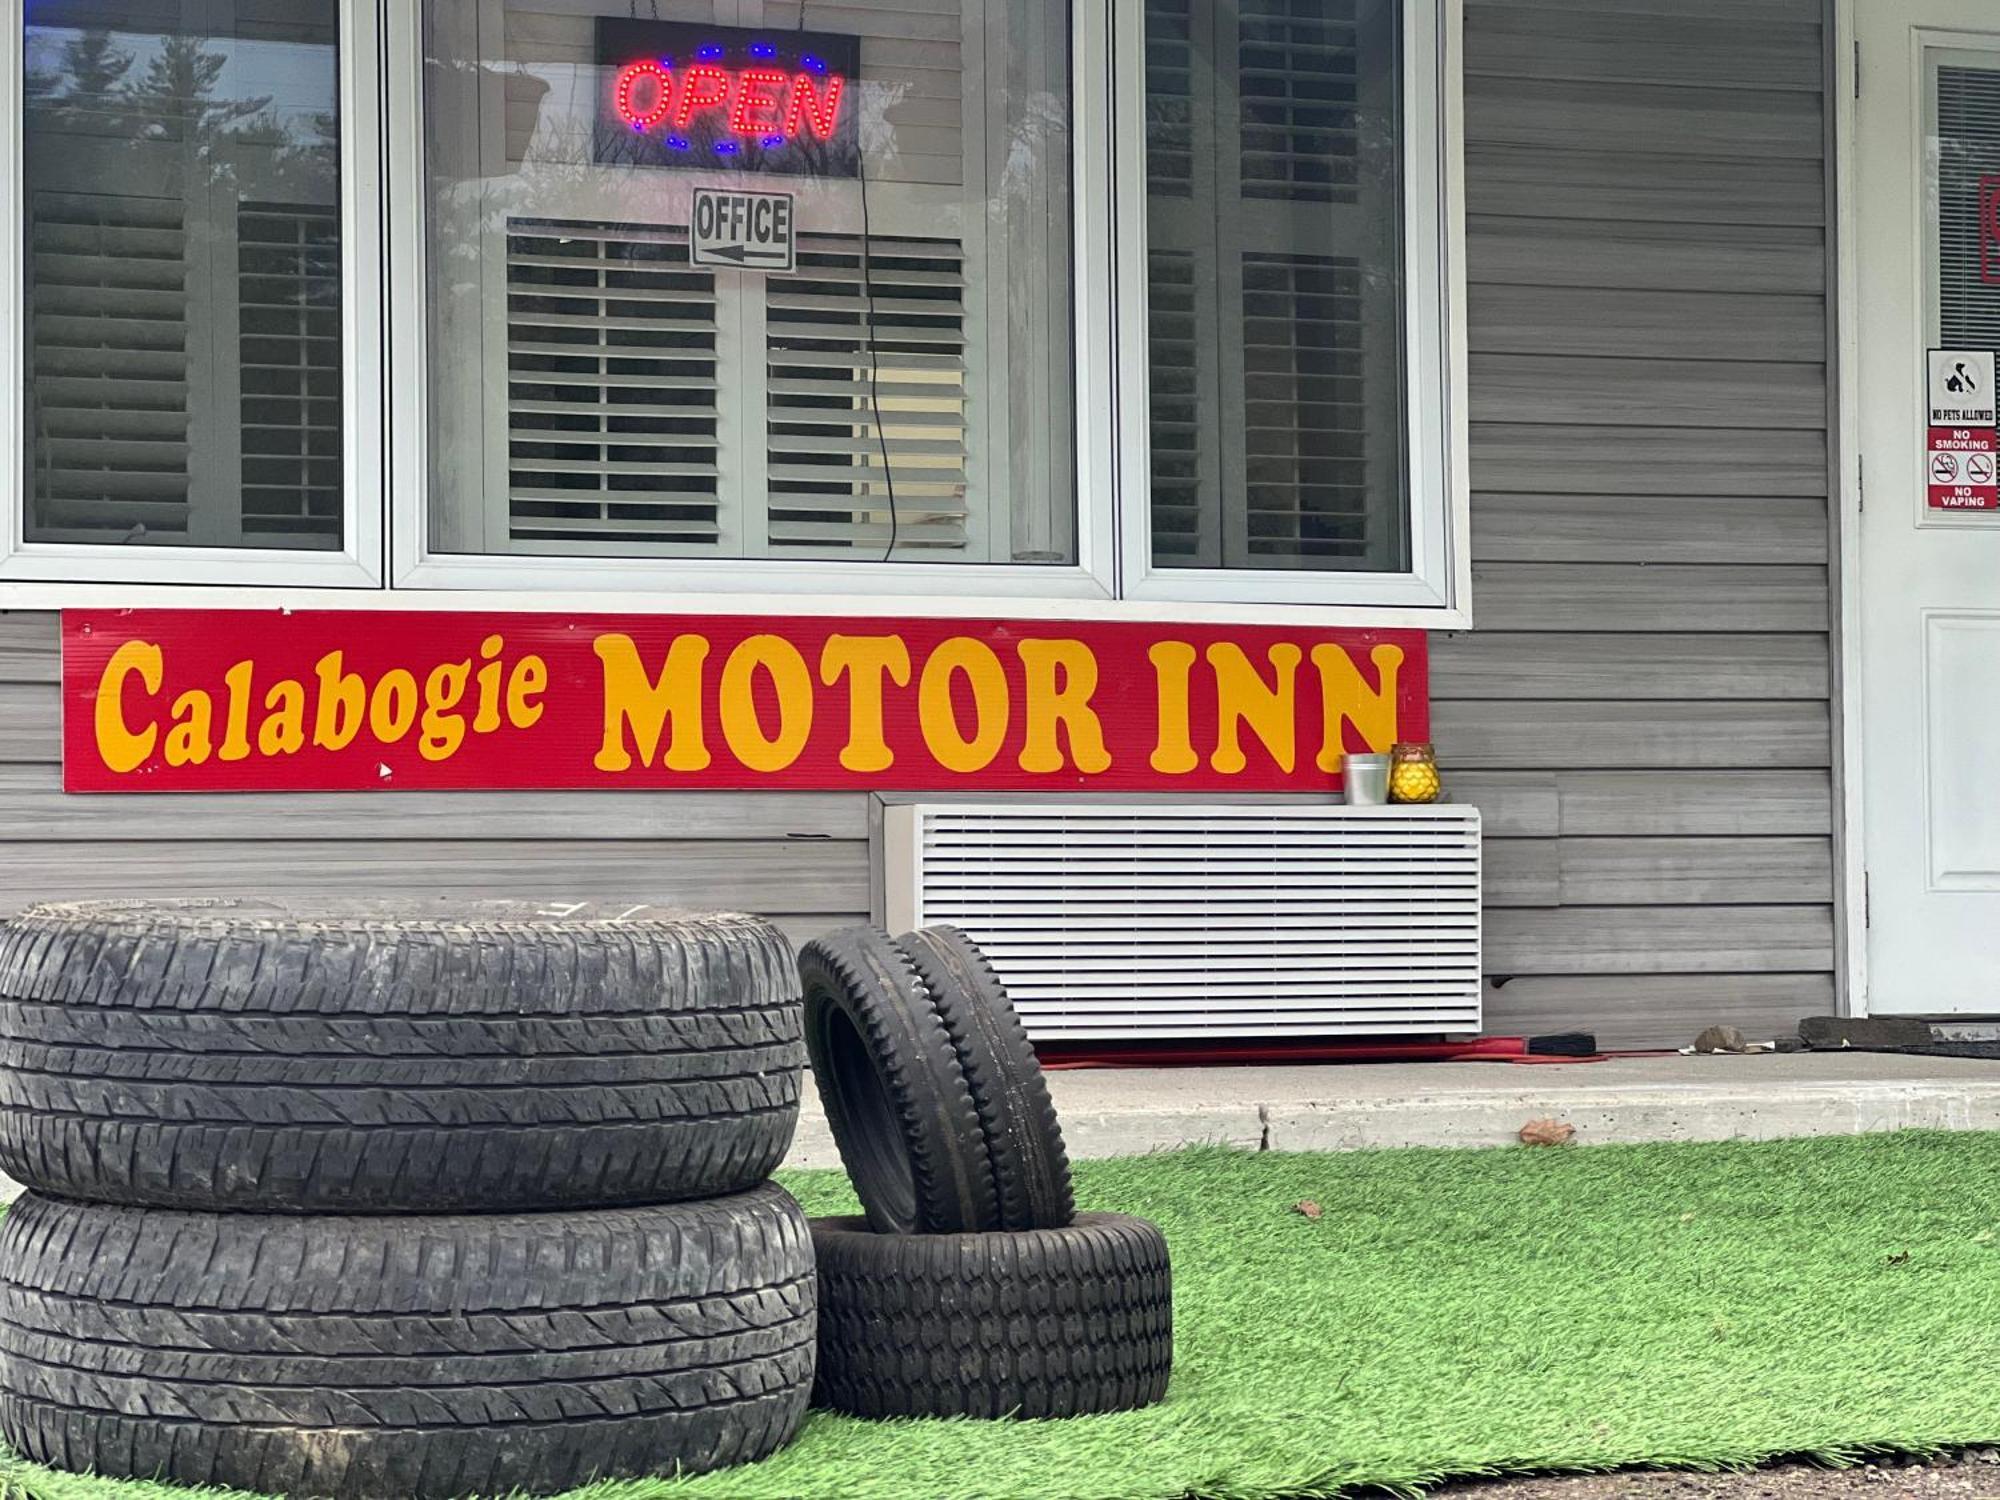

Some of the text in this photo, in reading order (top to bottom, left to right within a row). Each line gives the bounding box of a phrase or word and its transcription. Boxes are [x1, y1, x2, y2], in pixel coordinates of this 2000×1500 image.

[616, 61, 844, 138] OPEN
[697, 194, 788, 244] OFFICE
[1932, 409, 1993, 421] NO PETS ALLOWED
[1953, 430, 1970, 440] NO
[1935, 439, 1989, 450] SMOKING
[1954, 487, 1972, 497] NO
[1941, 496, 1985, 506] VAPING
[95, 633, 1404, 775] Calabogie MOTOR INN
